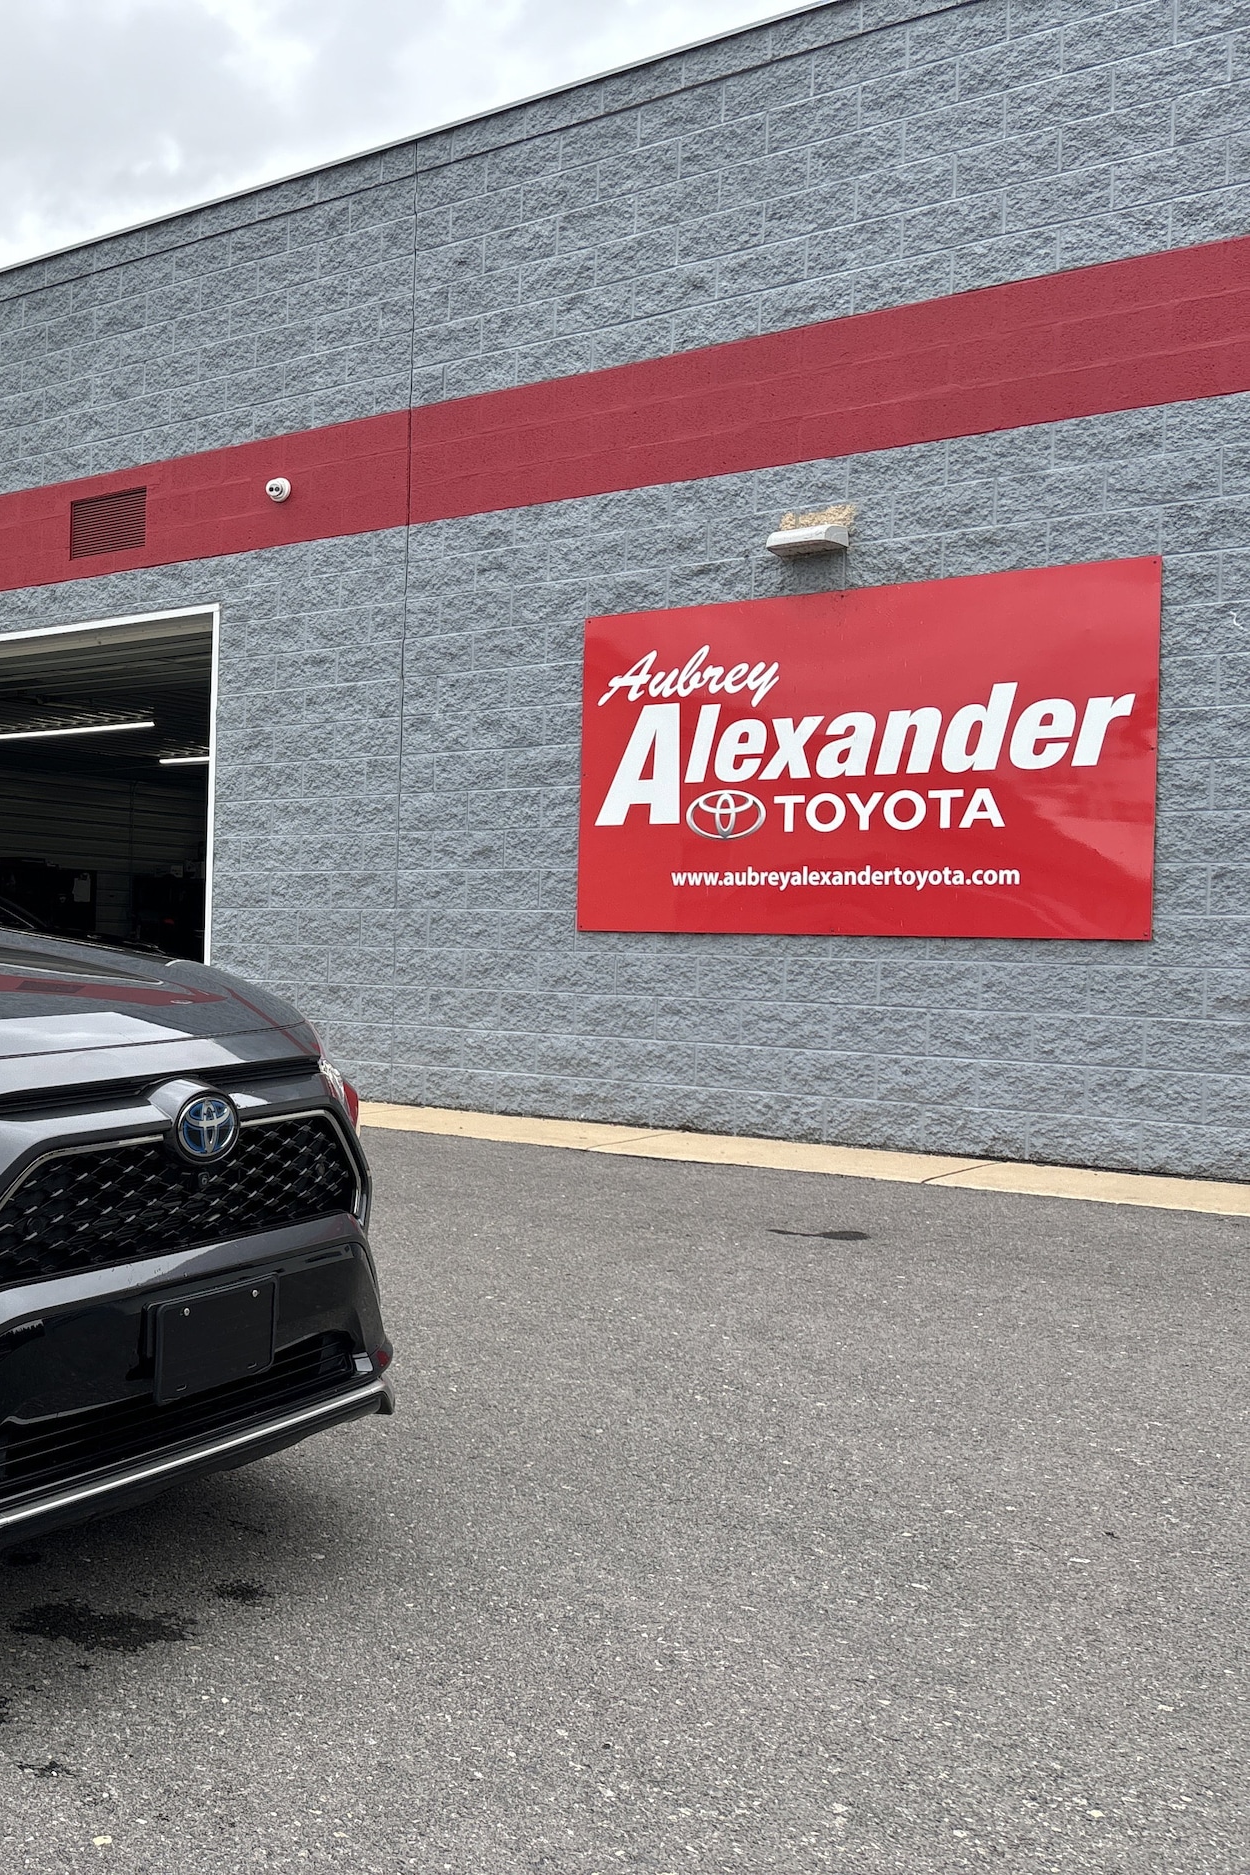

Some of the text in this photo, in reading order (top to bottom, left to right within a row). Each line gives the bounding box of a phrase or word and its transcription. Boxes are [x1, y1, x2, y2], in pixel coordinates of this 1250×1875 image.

[597, 644, 780, 707] Aubrey
[595, 681, 1136, 827] Alexander
[773, 788, 1006, 834] TOYOTA
[671, 865, 1021, 891] www.aubreyalexandertoyota.com
